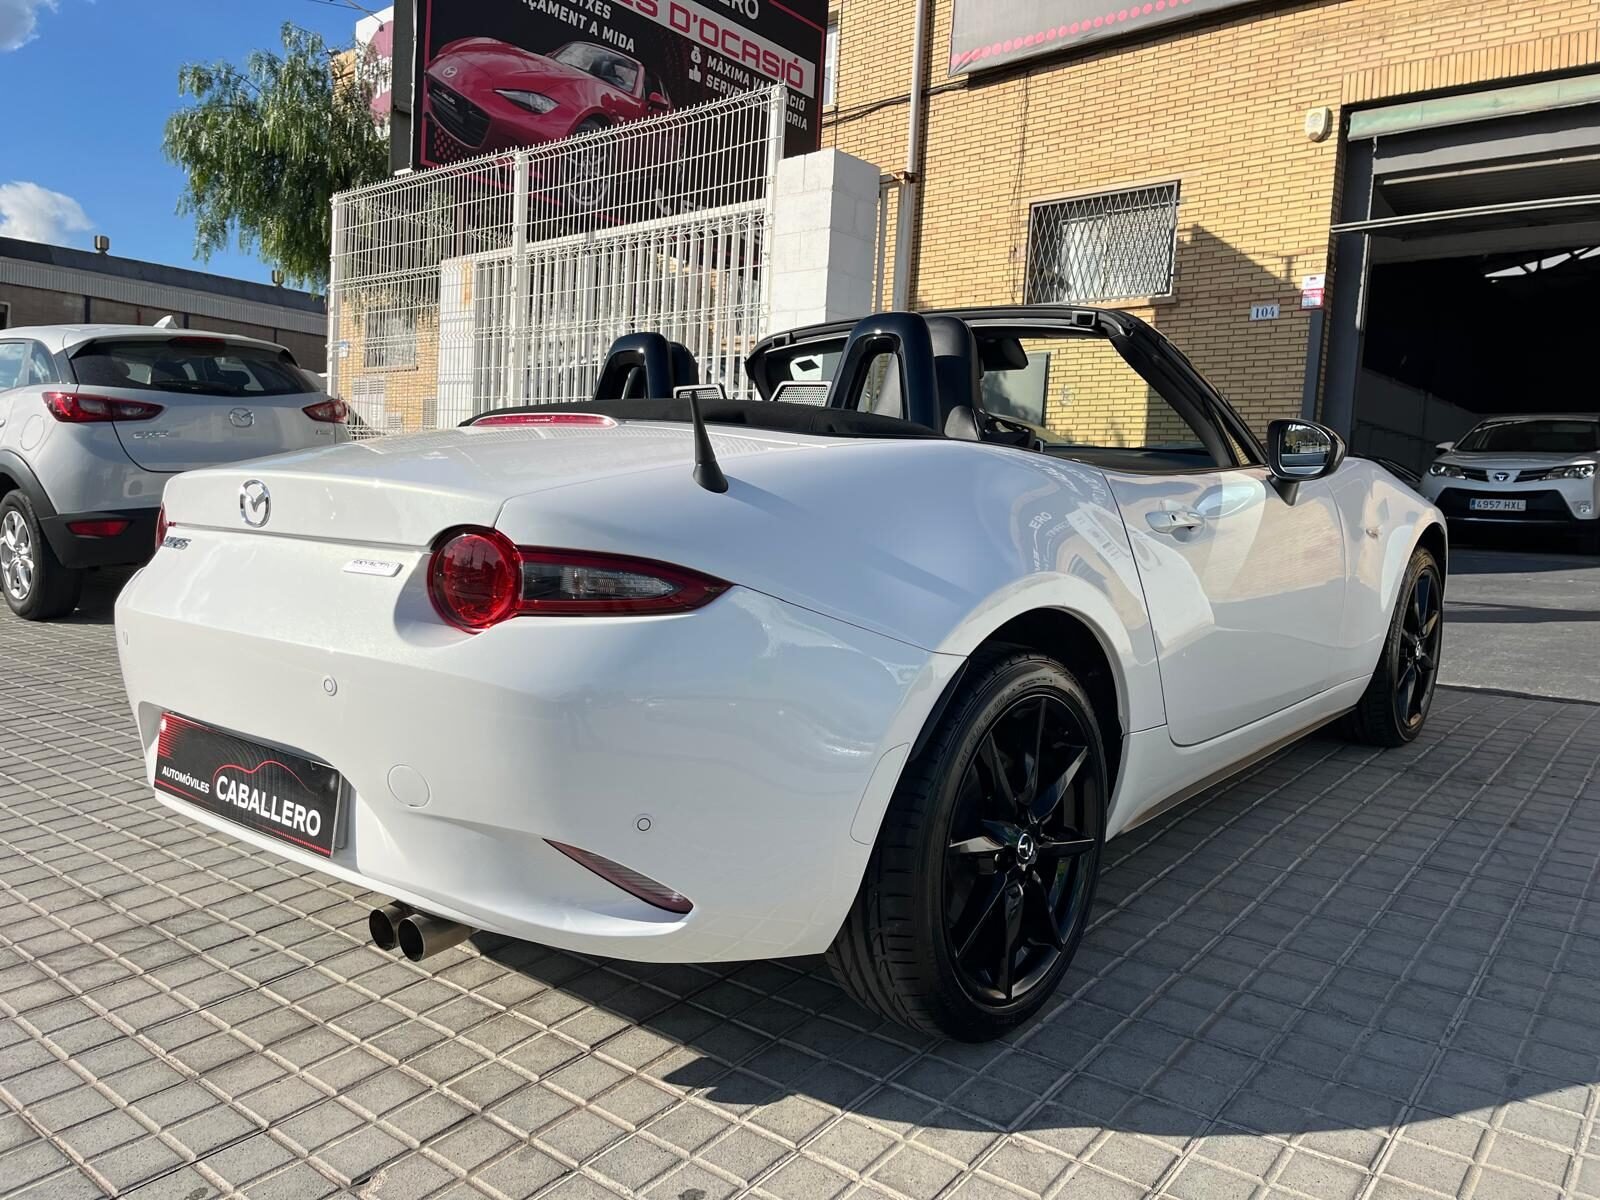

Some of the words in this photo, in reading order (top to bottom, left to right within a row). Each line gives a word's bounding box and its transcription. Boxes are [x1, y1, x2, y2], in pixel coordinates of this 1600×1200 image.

[523, 0, 588, 29] ÇAMENT
[589, 21, 598, 36] A
[602, 26, 635, 53] MIDA
[670, 2, 804, 89] D'OCASIÓ
[706, 55, 750, 86] MÀXIMA
[1255, 306, 1275, 318] 104
[1476, 501, 1501, 509] 4957
[1504, 501, 1521, 510] HXL
[161, 765, 210, 794] AUTOMÓVILES
[216, 775, 321, 837] CABALLERO
